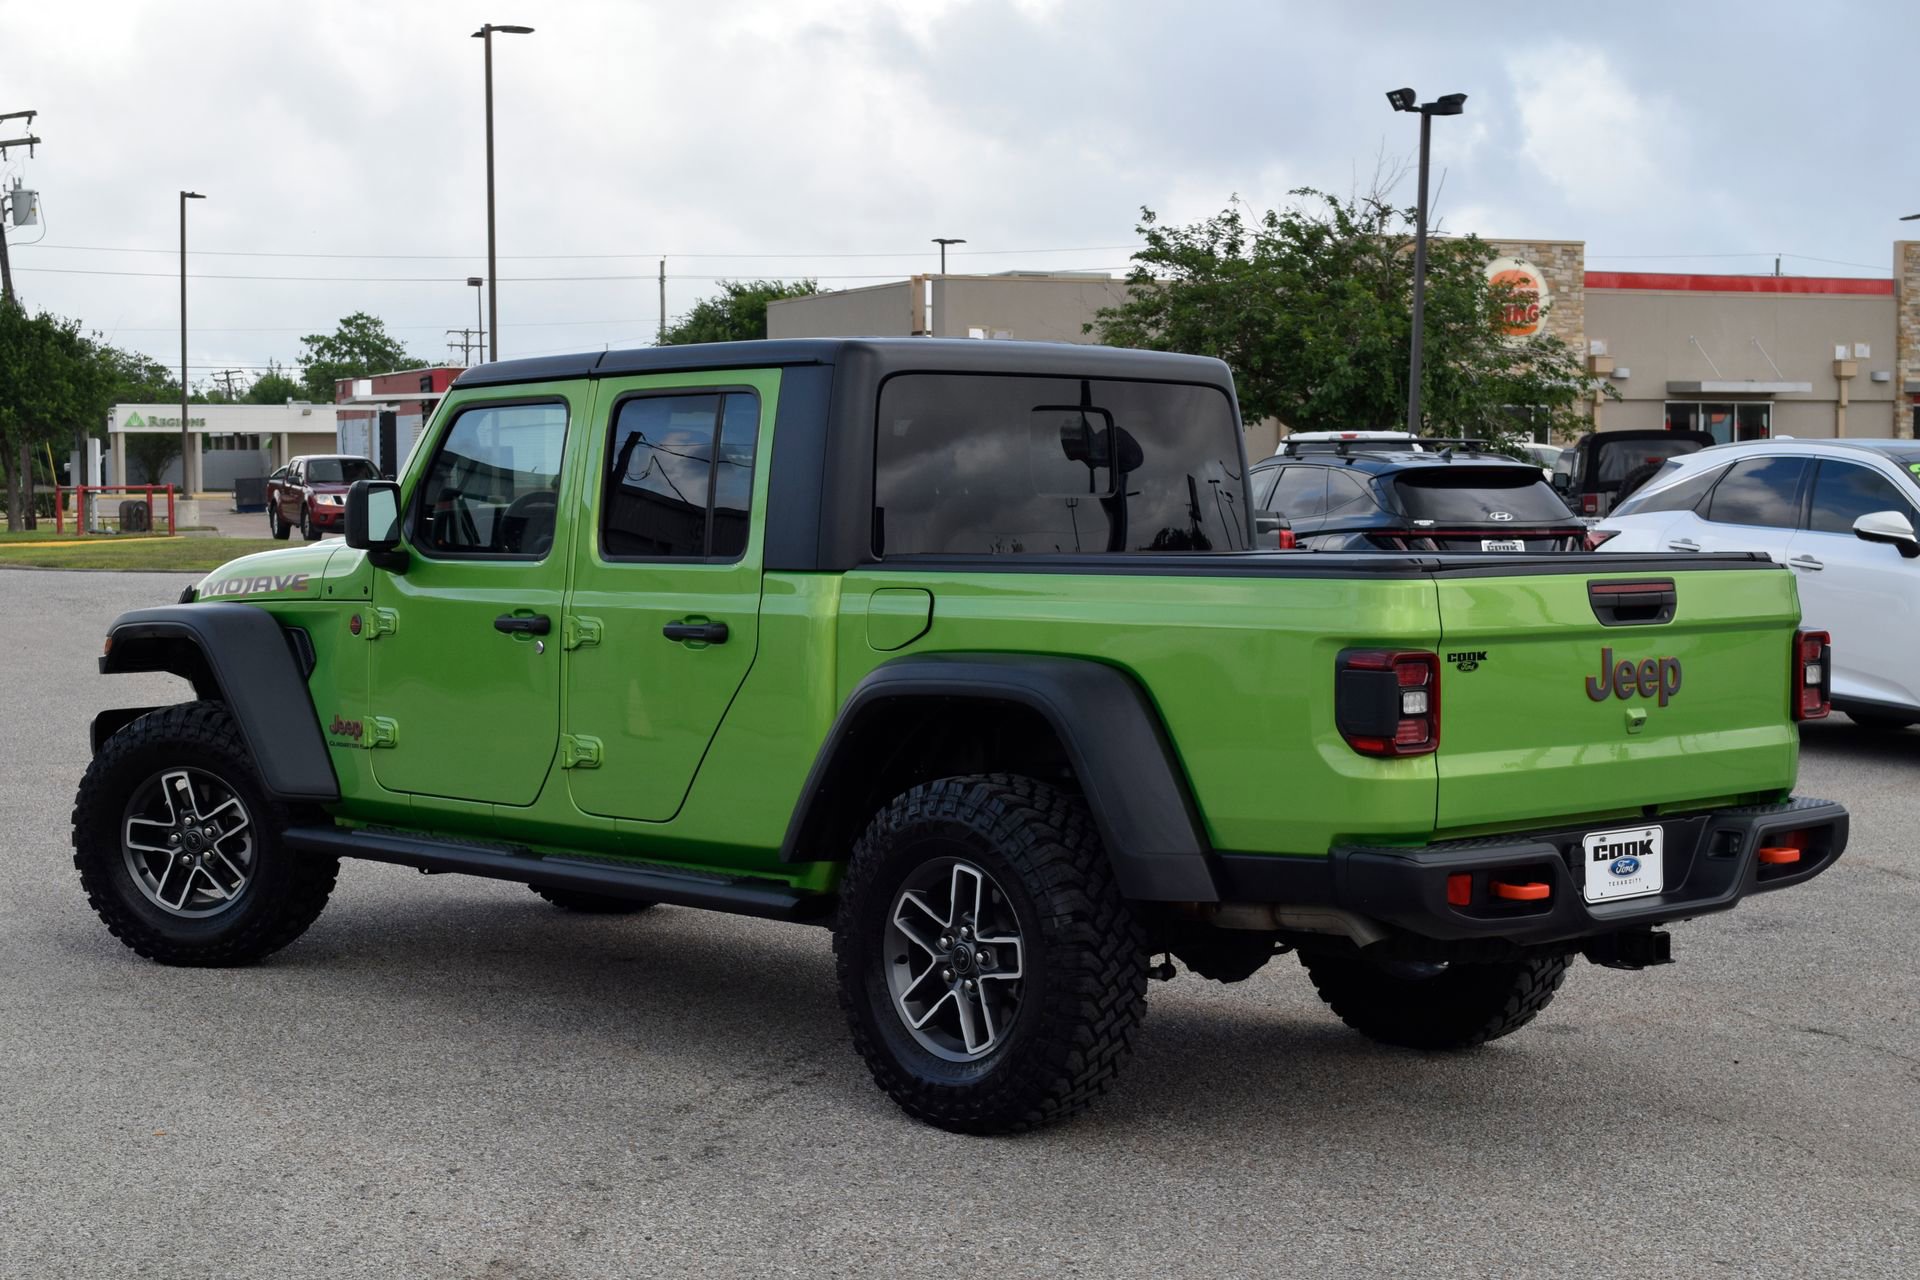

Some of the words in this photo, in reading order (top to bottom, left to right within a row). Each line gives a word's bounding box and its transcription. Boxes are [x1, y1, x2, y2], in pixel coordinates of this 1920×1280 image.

[201, 574, 309, 598] MOJAVE
[1447, 651, 1488, 662] COOK
[1585, 647, 1682, 708] Jeep
[329, 713, 363, 741] Jeep
[1593, 839, 1654, 862] COOK
[1615, 859, 1635, 874] Ford
